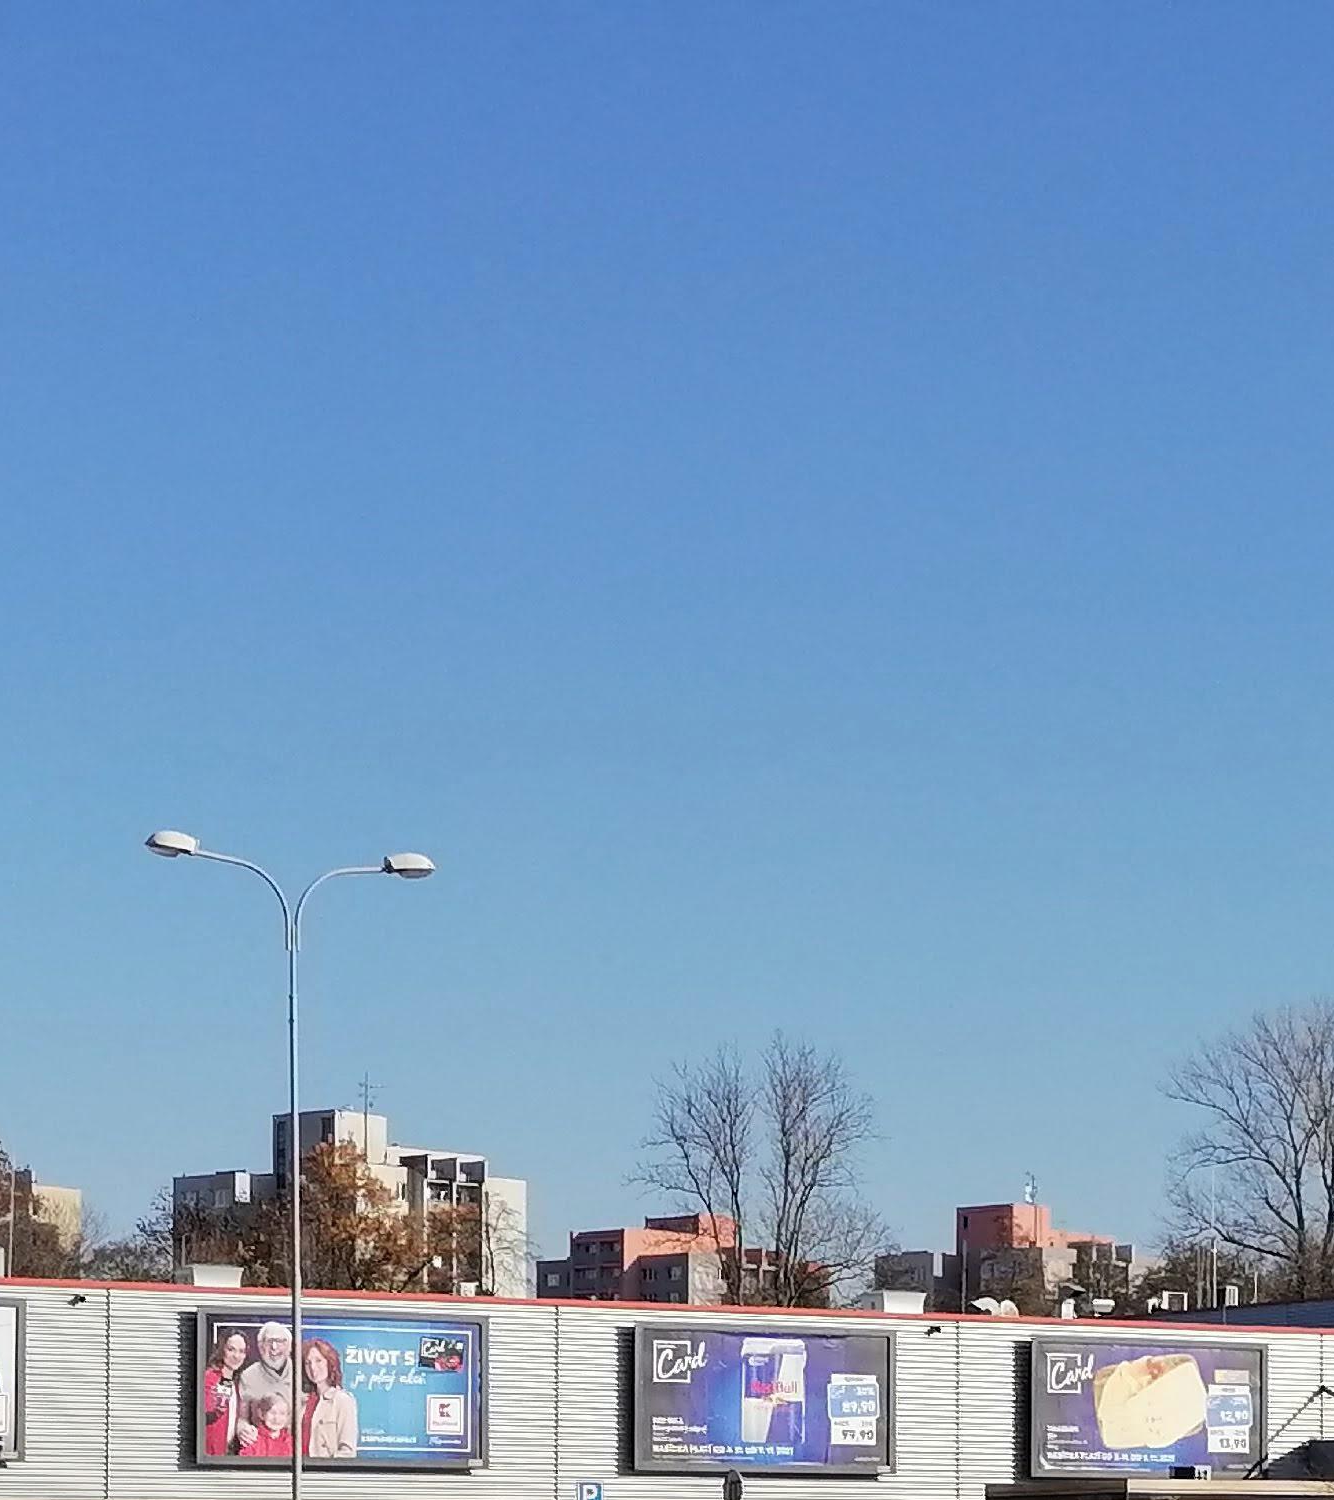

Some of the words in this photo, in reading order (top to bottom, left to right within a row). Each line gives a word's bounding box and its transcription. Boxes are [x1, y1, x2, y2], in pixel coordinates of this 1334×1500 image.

[346, 1344, 401, 1366] ŽIVOT
[657, 1341, 707, 1379] Card
[1051, 1354, 1095, 1390] Card
